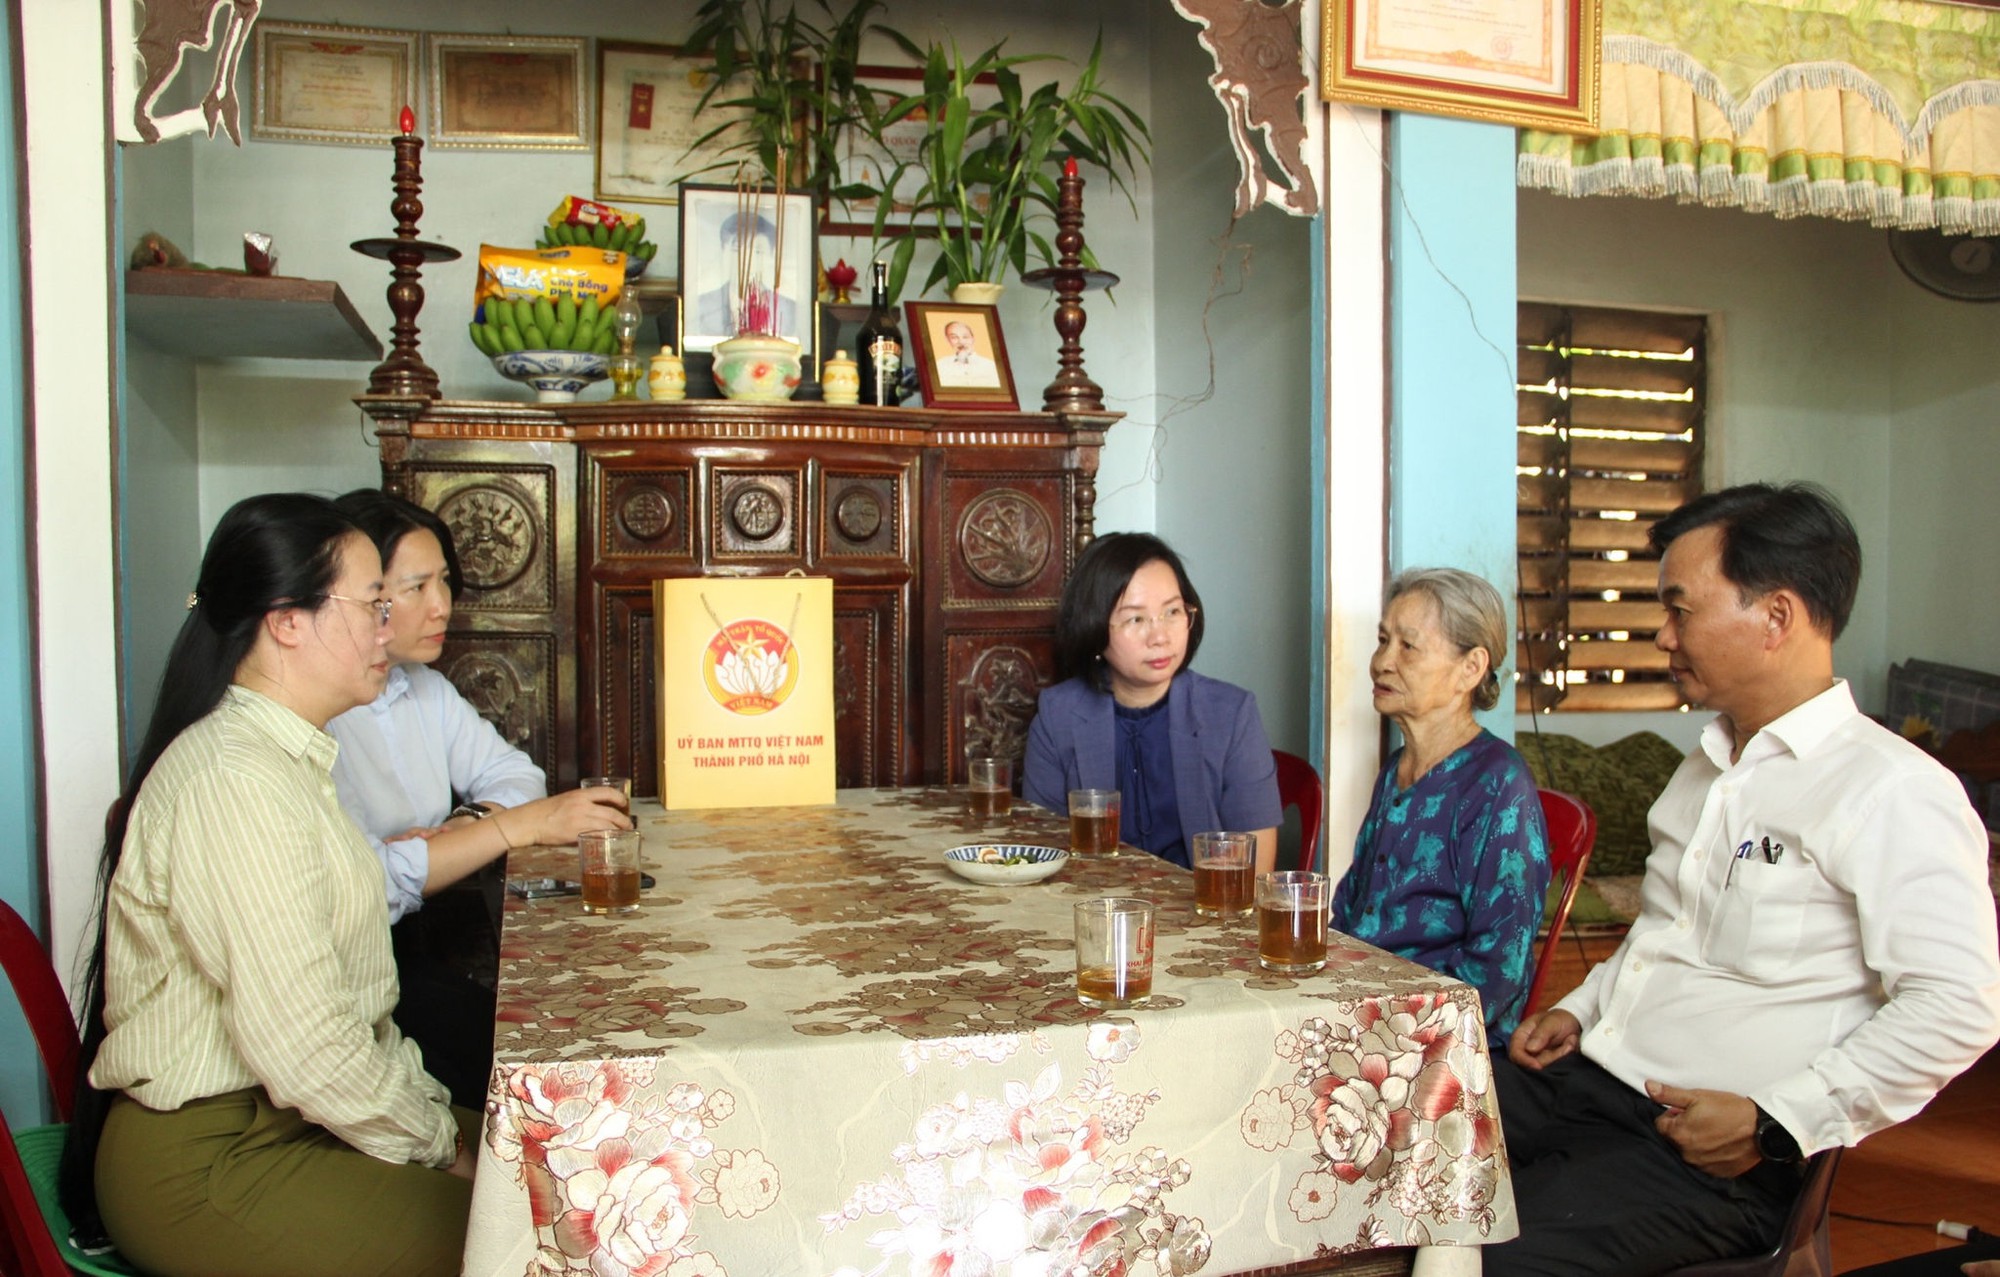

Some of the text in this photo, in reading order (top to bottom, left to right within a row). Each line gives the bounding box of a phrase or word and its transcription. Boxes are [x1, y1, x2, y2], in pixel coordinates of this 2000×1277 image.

[697, 737, 725, 749] BAN
[728, 736, 762, 749] MTTQ
[765, 734, 792, 749] VIỆT
[795, 735, 824, 747] NAM
[693, 751, 810, 768] THÀNH PHỐ HÀ NỘI
